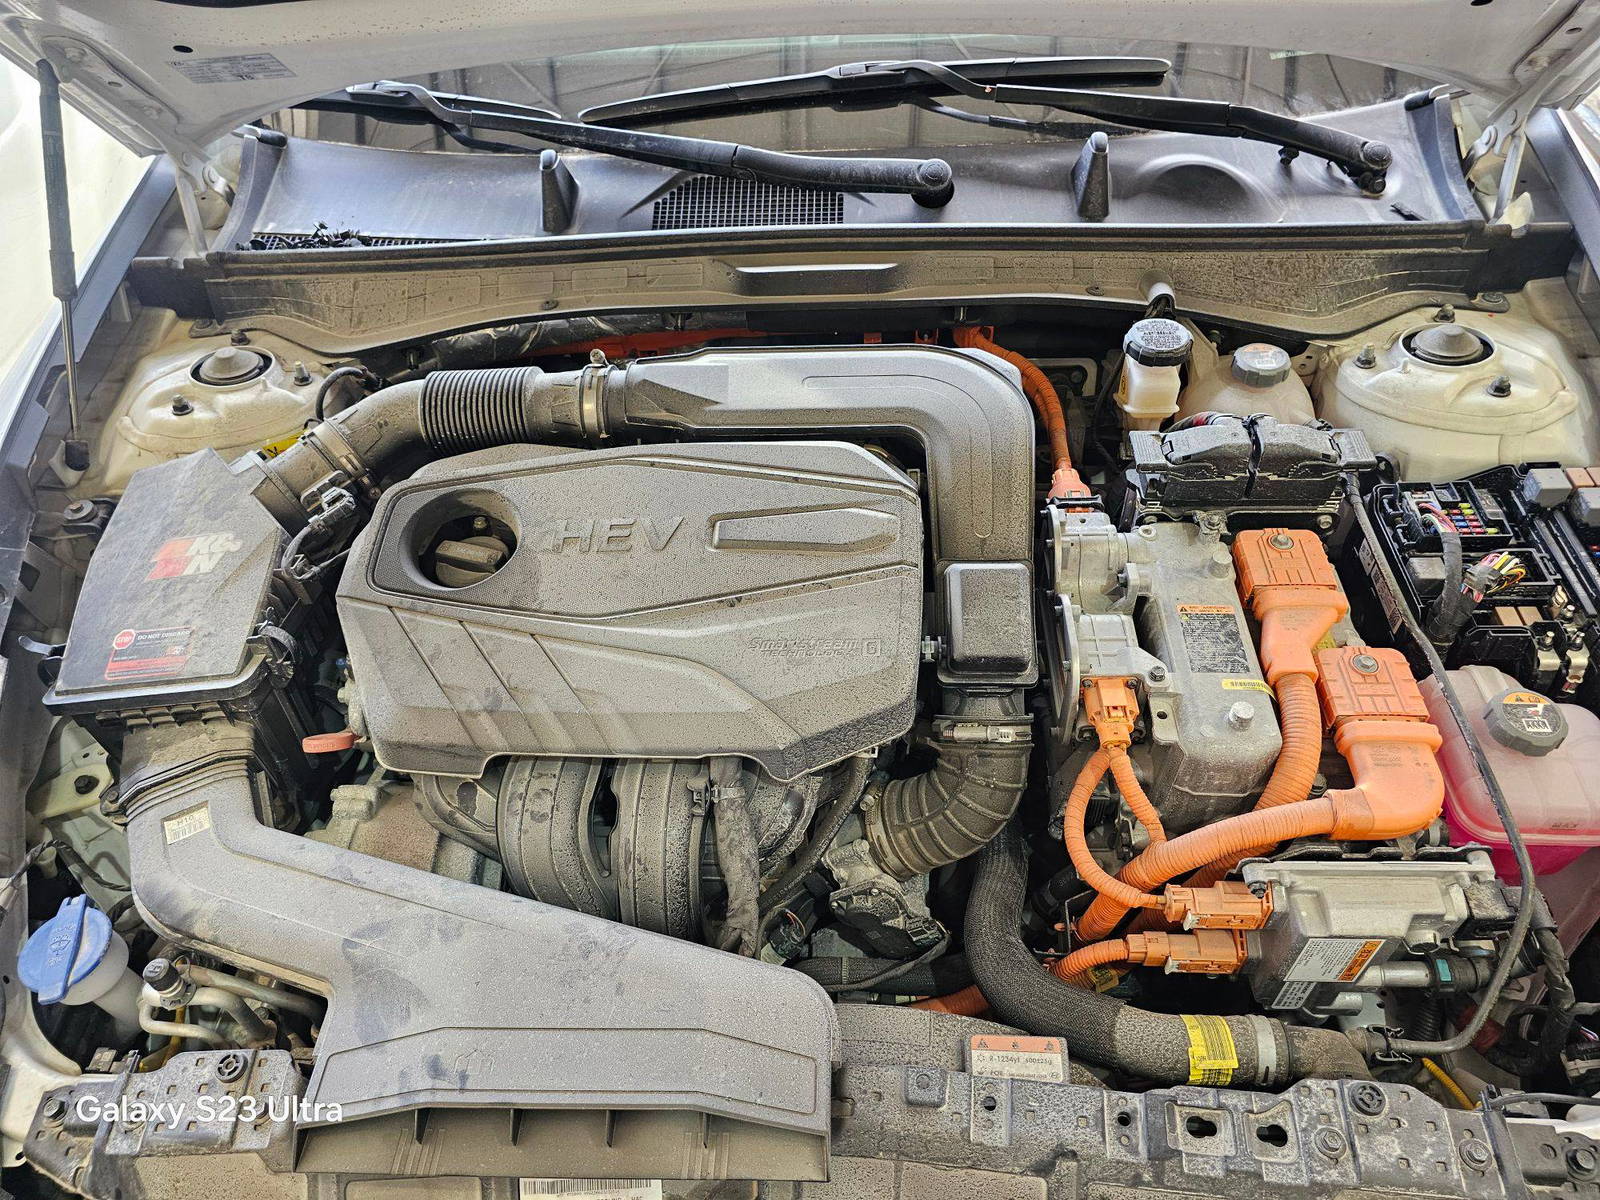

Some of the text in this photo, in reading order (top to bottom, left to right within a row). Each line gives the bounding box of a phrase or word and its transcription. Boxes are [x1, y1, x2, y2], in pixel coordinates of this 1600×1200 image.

[551, 515, 686, 553] HEV
[148, 632, 161, 640] NOT
[748, 637, 859, 651] Smartstream
[760, 648, 855, 659] TECHNOLOGY
